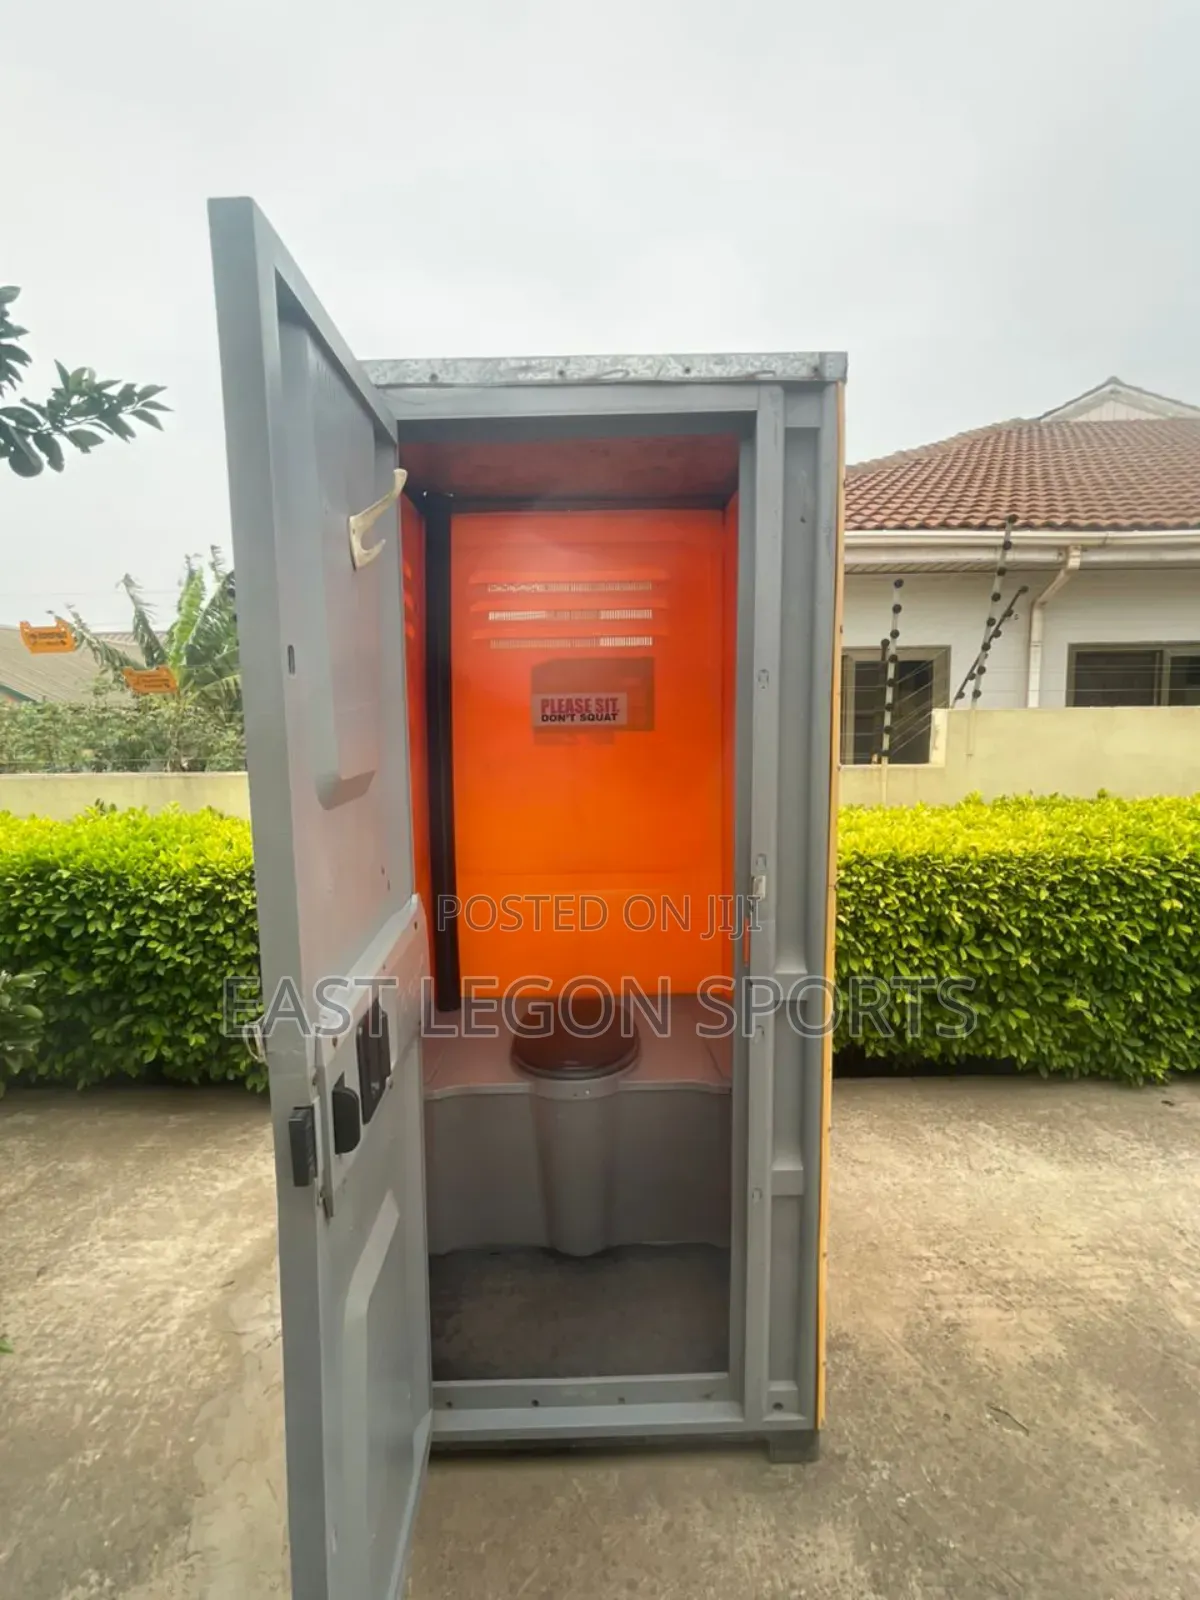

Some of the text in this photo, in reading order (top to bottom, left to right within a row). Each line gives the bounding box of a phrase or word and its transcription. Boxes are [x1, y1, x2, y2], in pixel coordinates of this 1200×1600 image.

[541, 698, 592, 713] PLEASE
[541, 713, 618, 722] DON'T SQUAT
